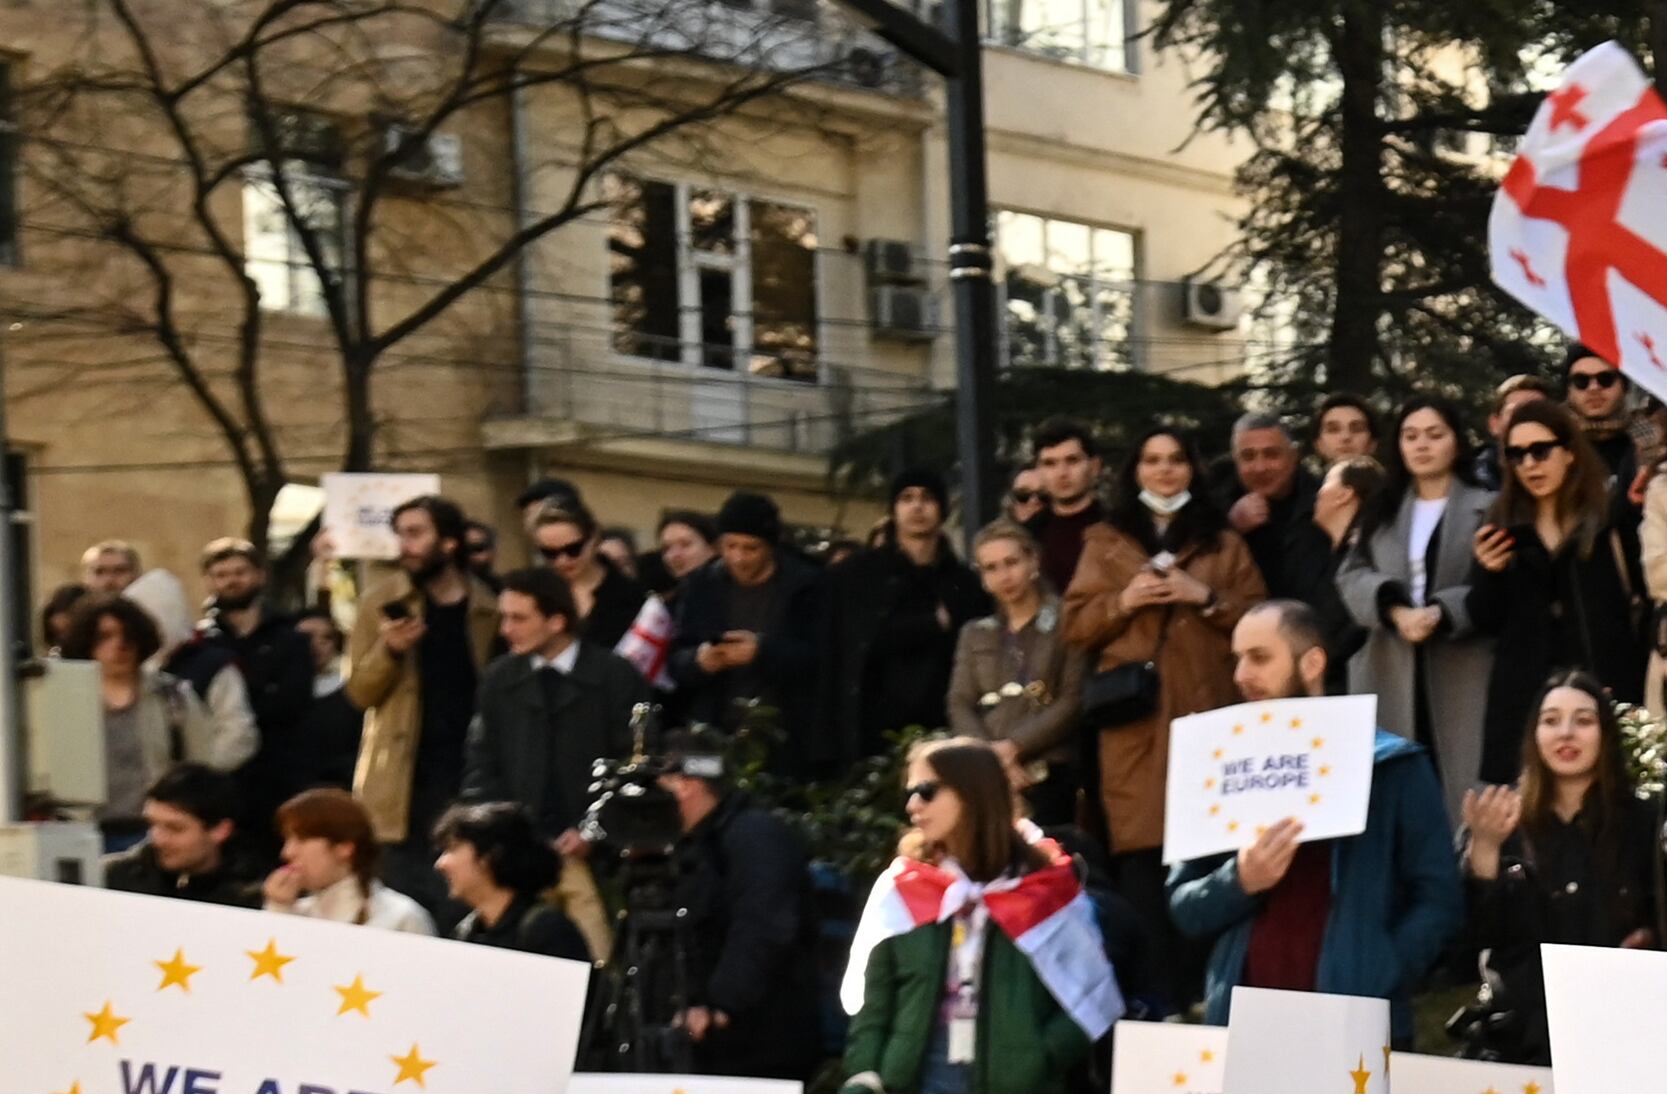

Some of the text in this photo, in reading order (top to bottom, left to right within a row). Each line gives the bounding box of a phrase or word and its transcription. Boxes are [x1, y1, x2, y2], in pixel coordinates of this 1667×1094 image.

[1223, 753, 1309, 776] WE ARE
[1221, 770, 1309, 795] EUROPE
